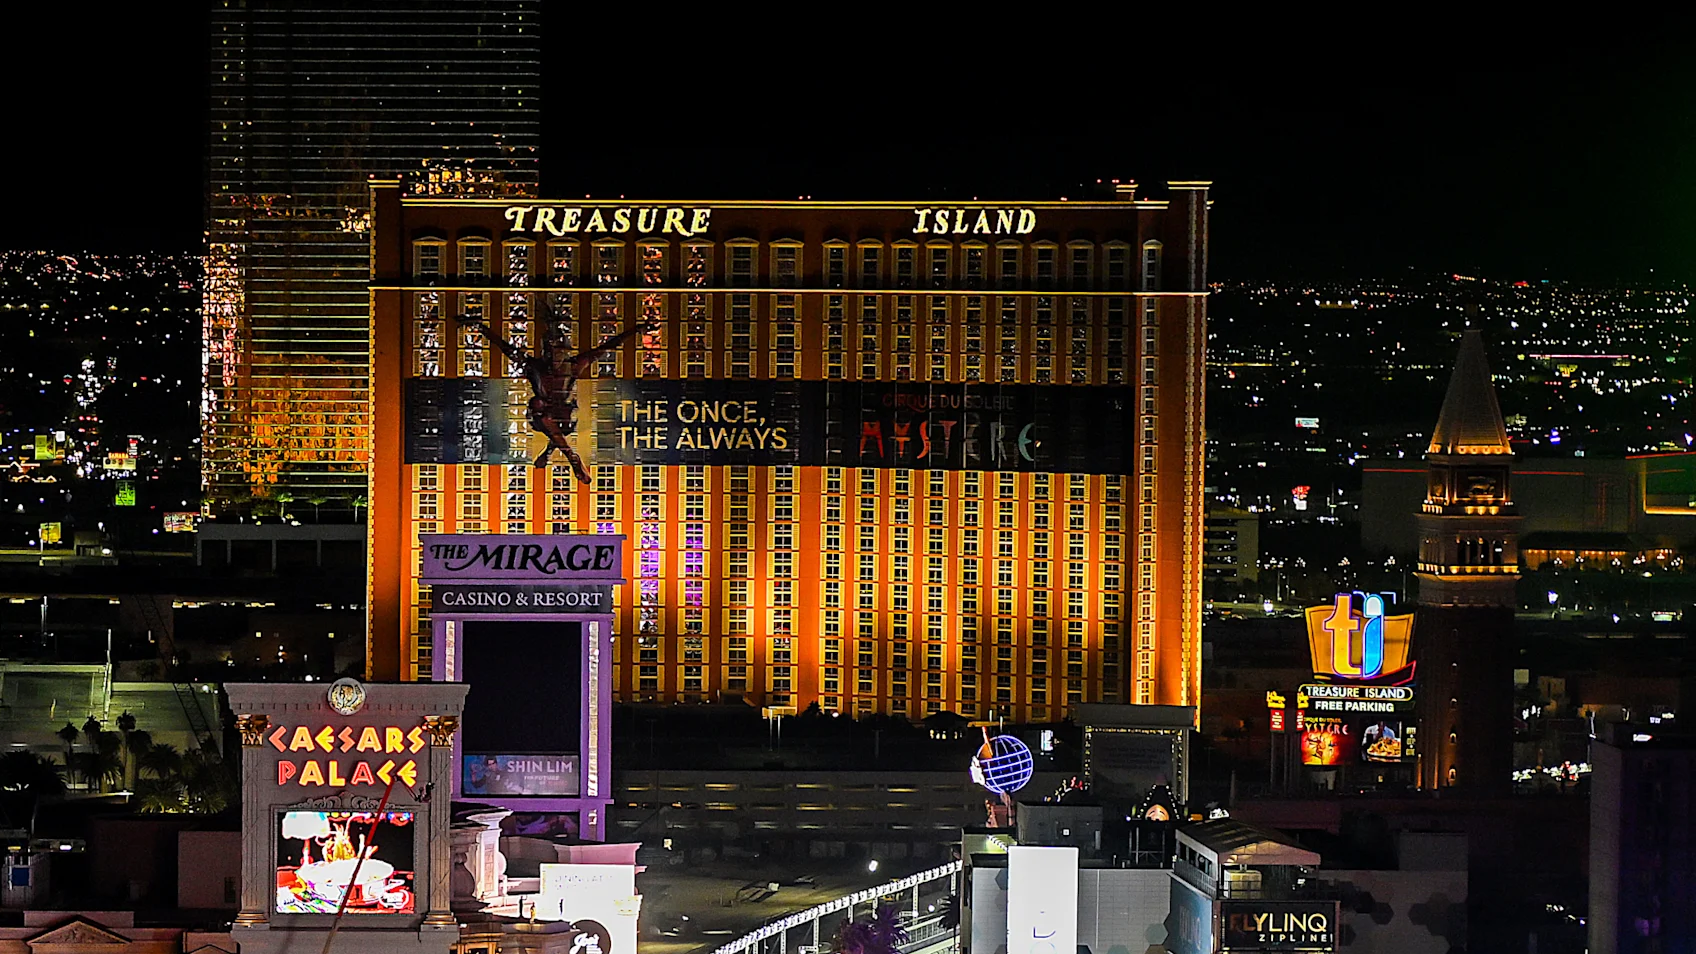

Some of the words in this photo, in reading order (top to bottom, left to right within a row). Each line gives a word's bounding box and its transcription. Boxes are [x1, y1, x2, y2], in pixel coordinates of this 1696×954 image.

[505, 206, 711, 236] TREASURE
[913, 209, 1036, 234] ISLAND
[620, 401, 668, 422] THE
[677, 401, 766, 426] ONCE,
[620, 427, 668, 449] THE
[676, 427, 787, 449] ALWAYS
[430, 545, 469, 559] THE
[445, 544, 615, 574] MIRAGE
[442, 592, 510, 606] CASINO
[515, 592, 529, 606] &
[533, 592, 602, 606] RESORT
[1306, 686, 1360, 697] TREASURE
[1365, 687, 1406, 699] ISLAND
[1315, 701, 1343, 711] FREE
[1345, 702, 1394, 712] PARKING
[269, 725, 425, 754] CAESARS
[278, 760, 417, 787] PALACE
[507, 761, 542, 773] SHIN
[547, 761, 572, 773] LIM
[1230, 913, 1327, 932] FLYLINQ
